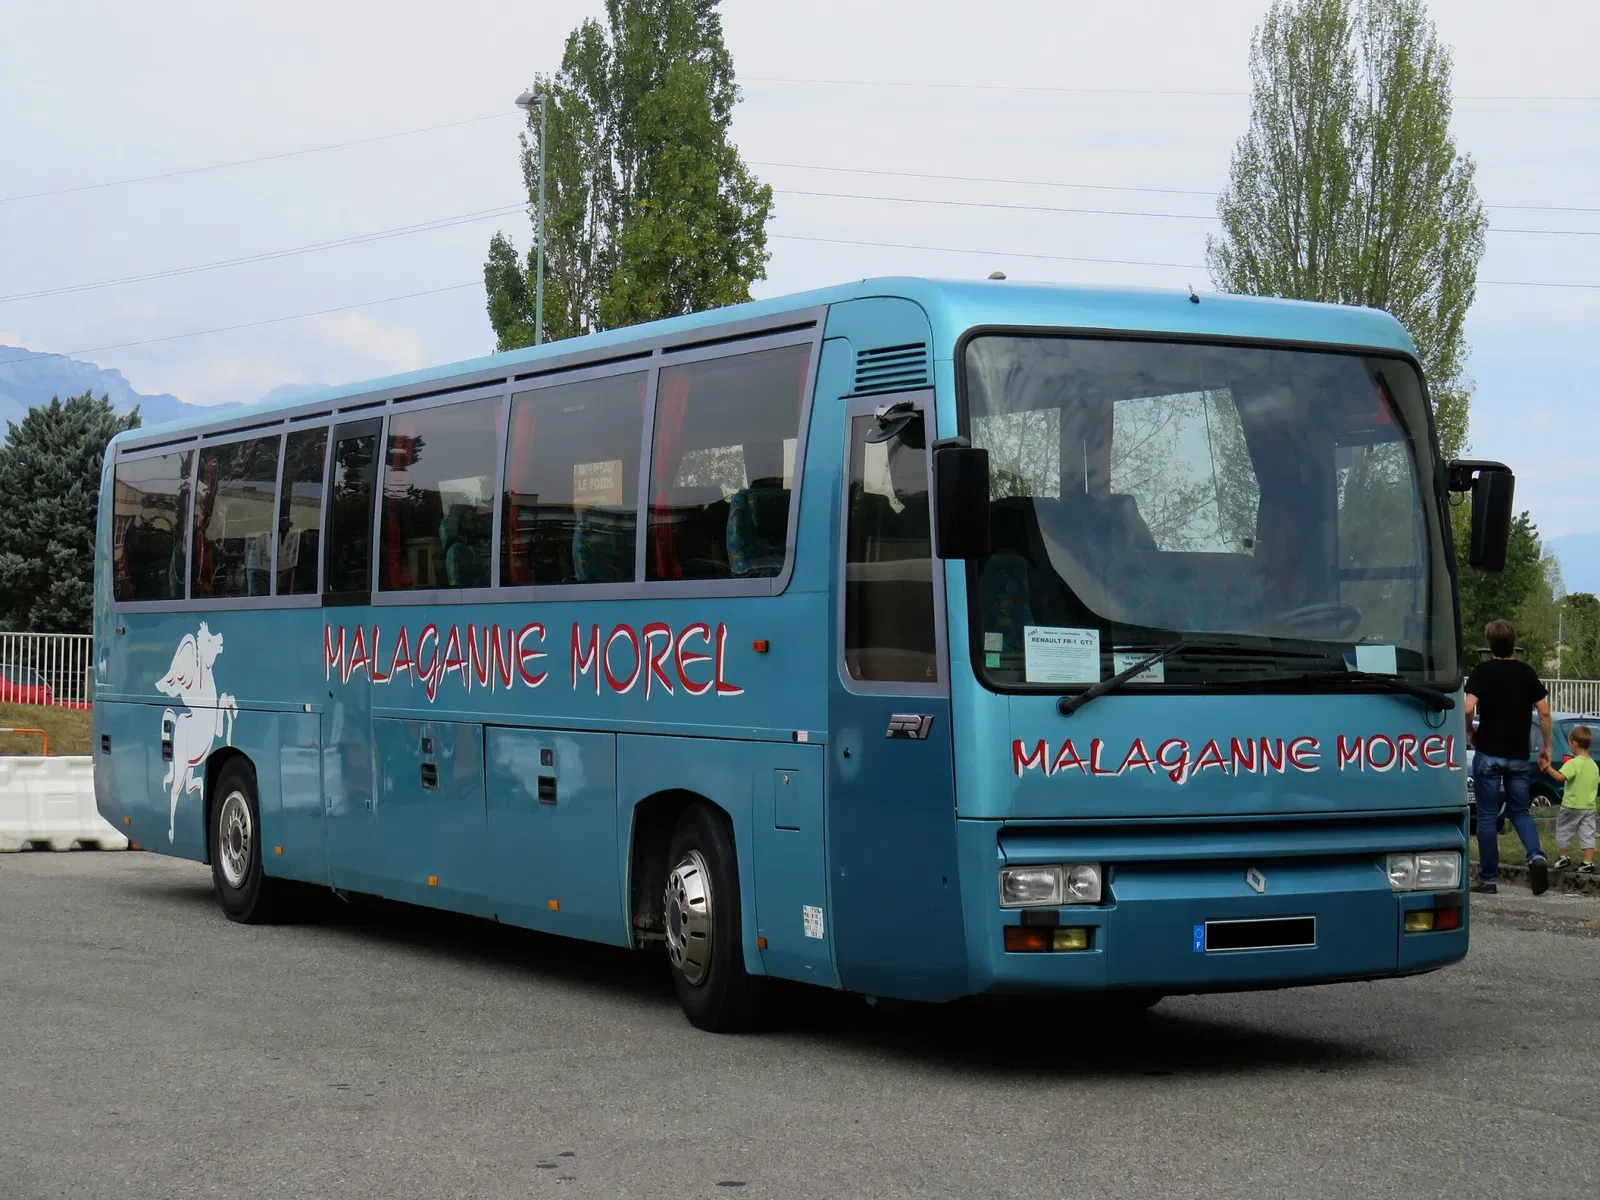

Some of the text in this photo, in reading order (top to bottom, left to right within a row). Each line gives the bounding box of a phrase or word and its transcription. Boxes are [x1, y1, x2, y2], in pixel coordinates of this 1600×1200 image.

[1031, 636, 1062, 644] RENAULT
[324, 622, 745, 703] MALAGANNE MOREL
[1012, 734, 1462, 785] MALAGANNE MOREL
[1196, 941, 1201, 949] F
